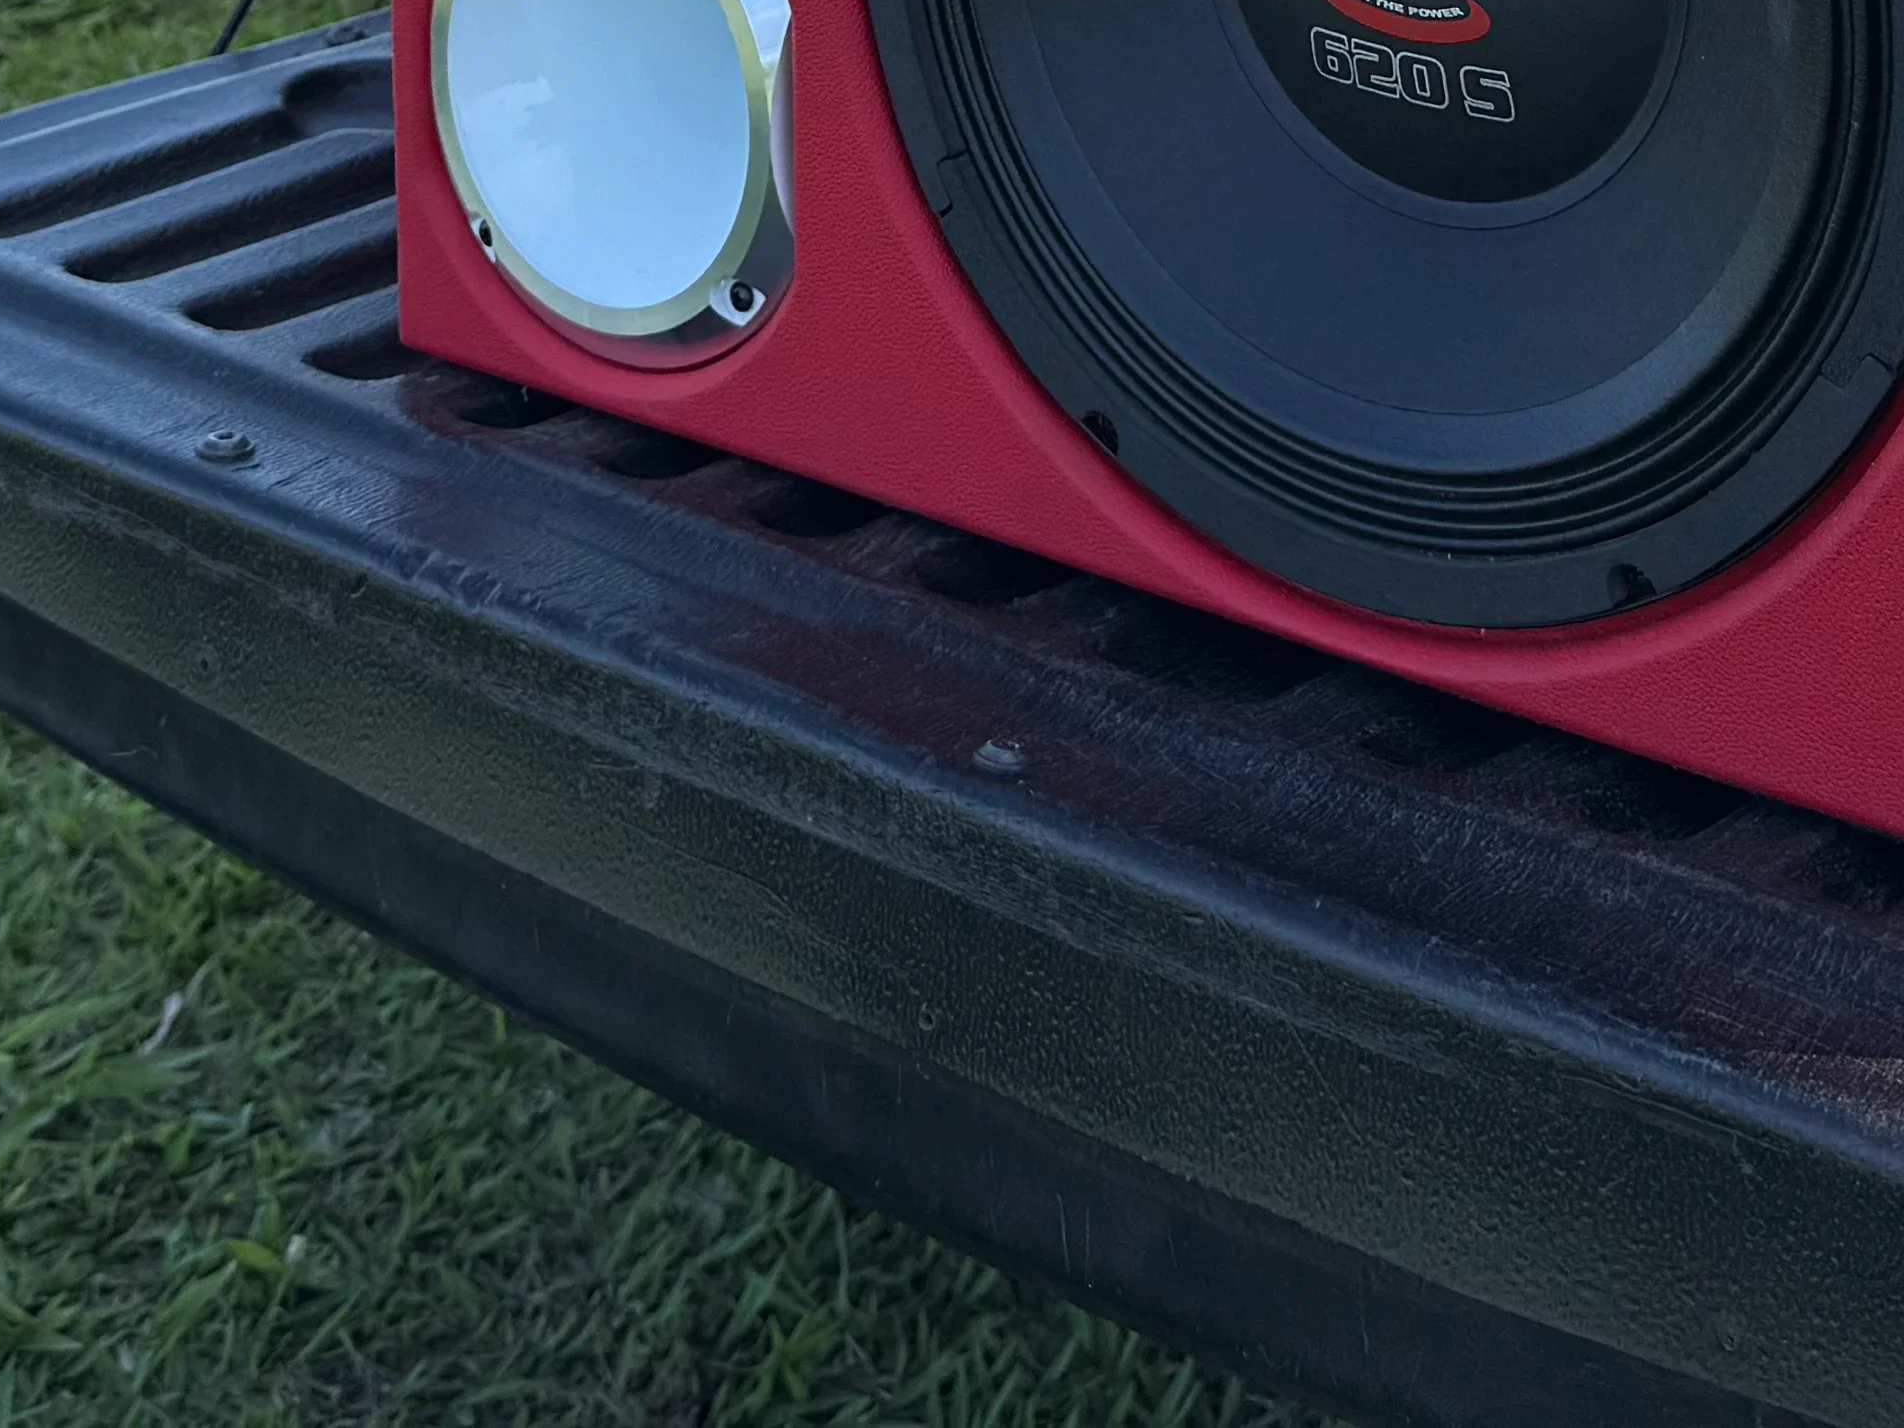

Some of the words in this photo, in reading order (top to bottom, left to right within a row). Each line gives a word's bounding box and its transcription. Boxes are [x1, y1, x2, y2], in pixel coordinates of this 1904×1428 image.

[1408, 7, 1465, 19] POWER
[1310, 26, 1449, 109] 620
[1459, 65, 1515, 122] S
